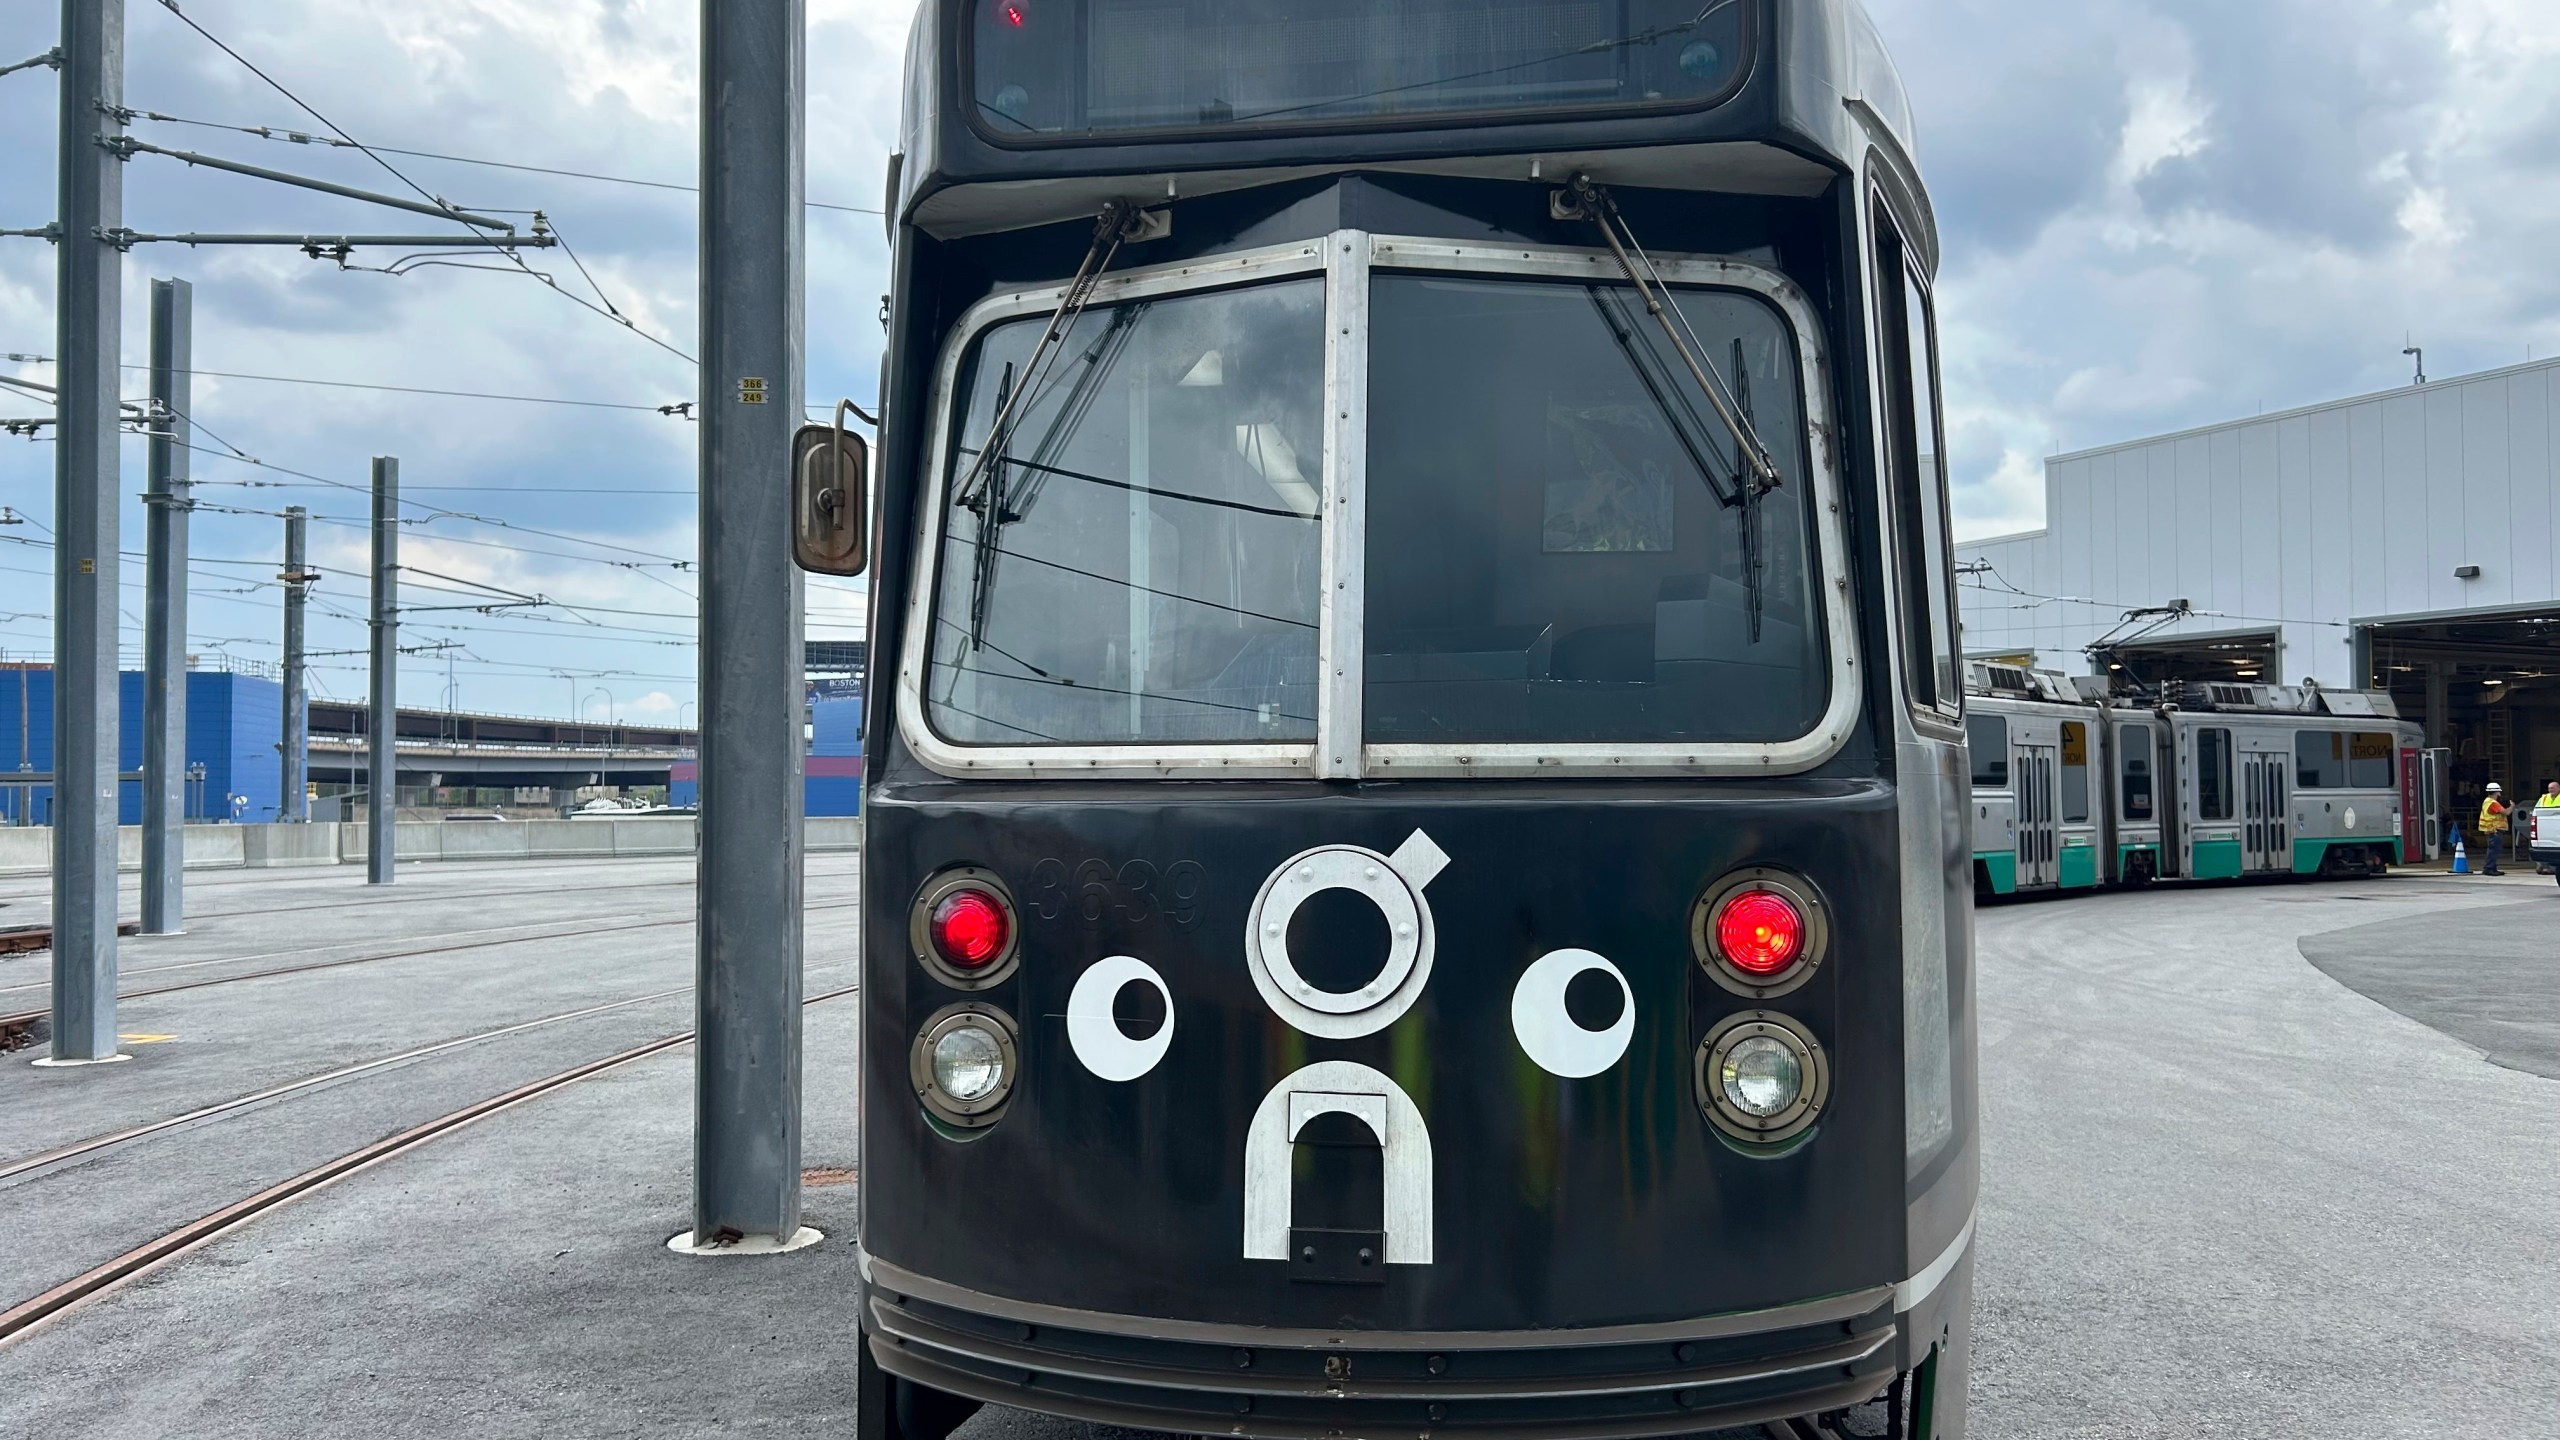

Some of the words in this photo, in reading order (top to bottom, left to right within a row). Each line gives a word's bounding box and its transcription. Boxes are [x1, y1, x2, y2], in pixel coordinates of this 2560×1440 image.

[743, 379, 762, 389] 366
[743, 393, 762, 402] 249
[829, 679, 861, 688] BOSTON
[2407, 767, 2415, 810] STOP
[1028, 857, 1209, 934] 3639
